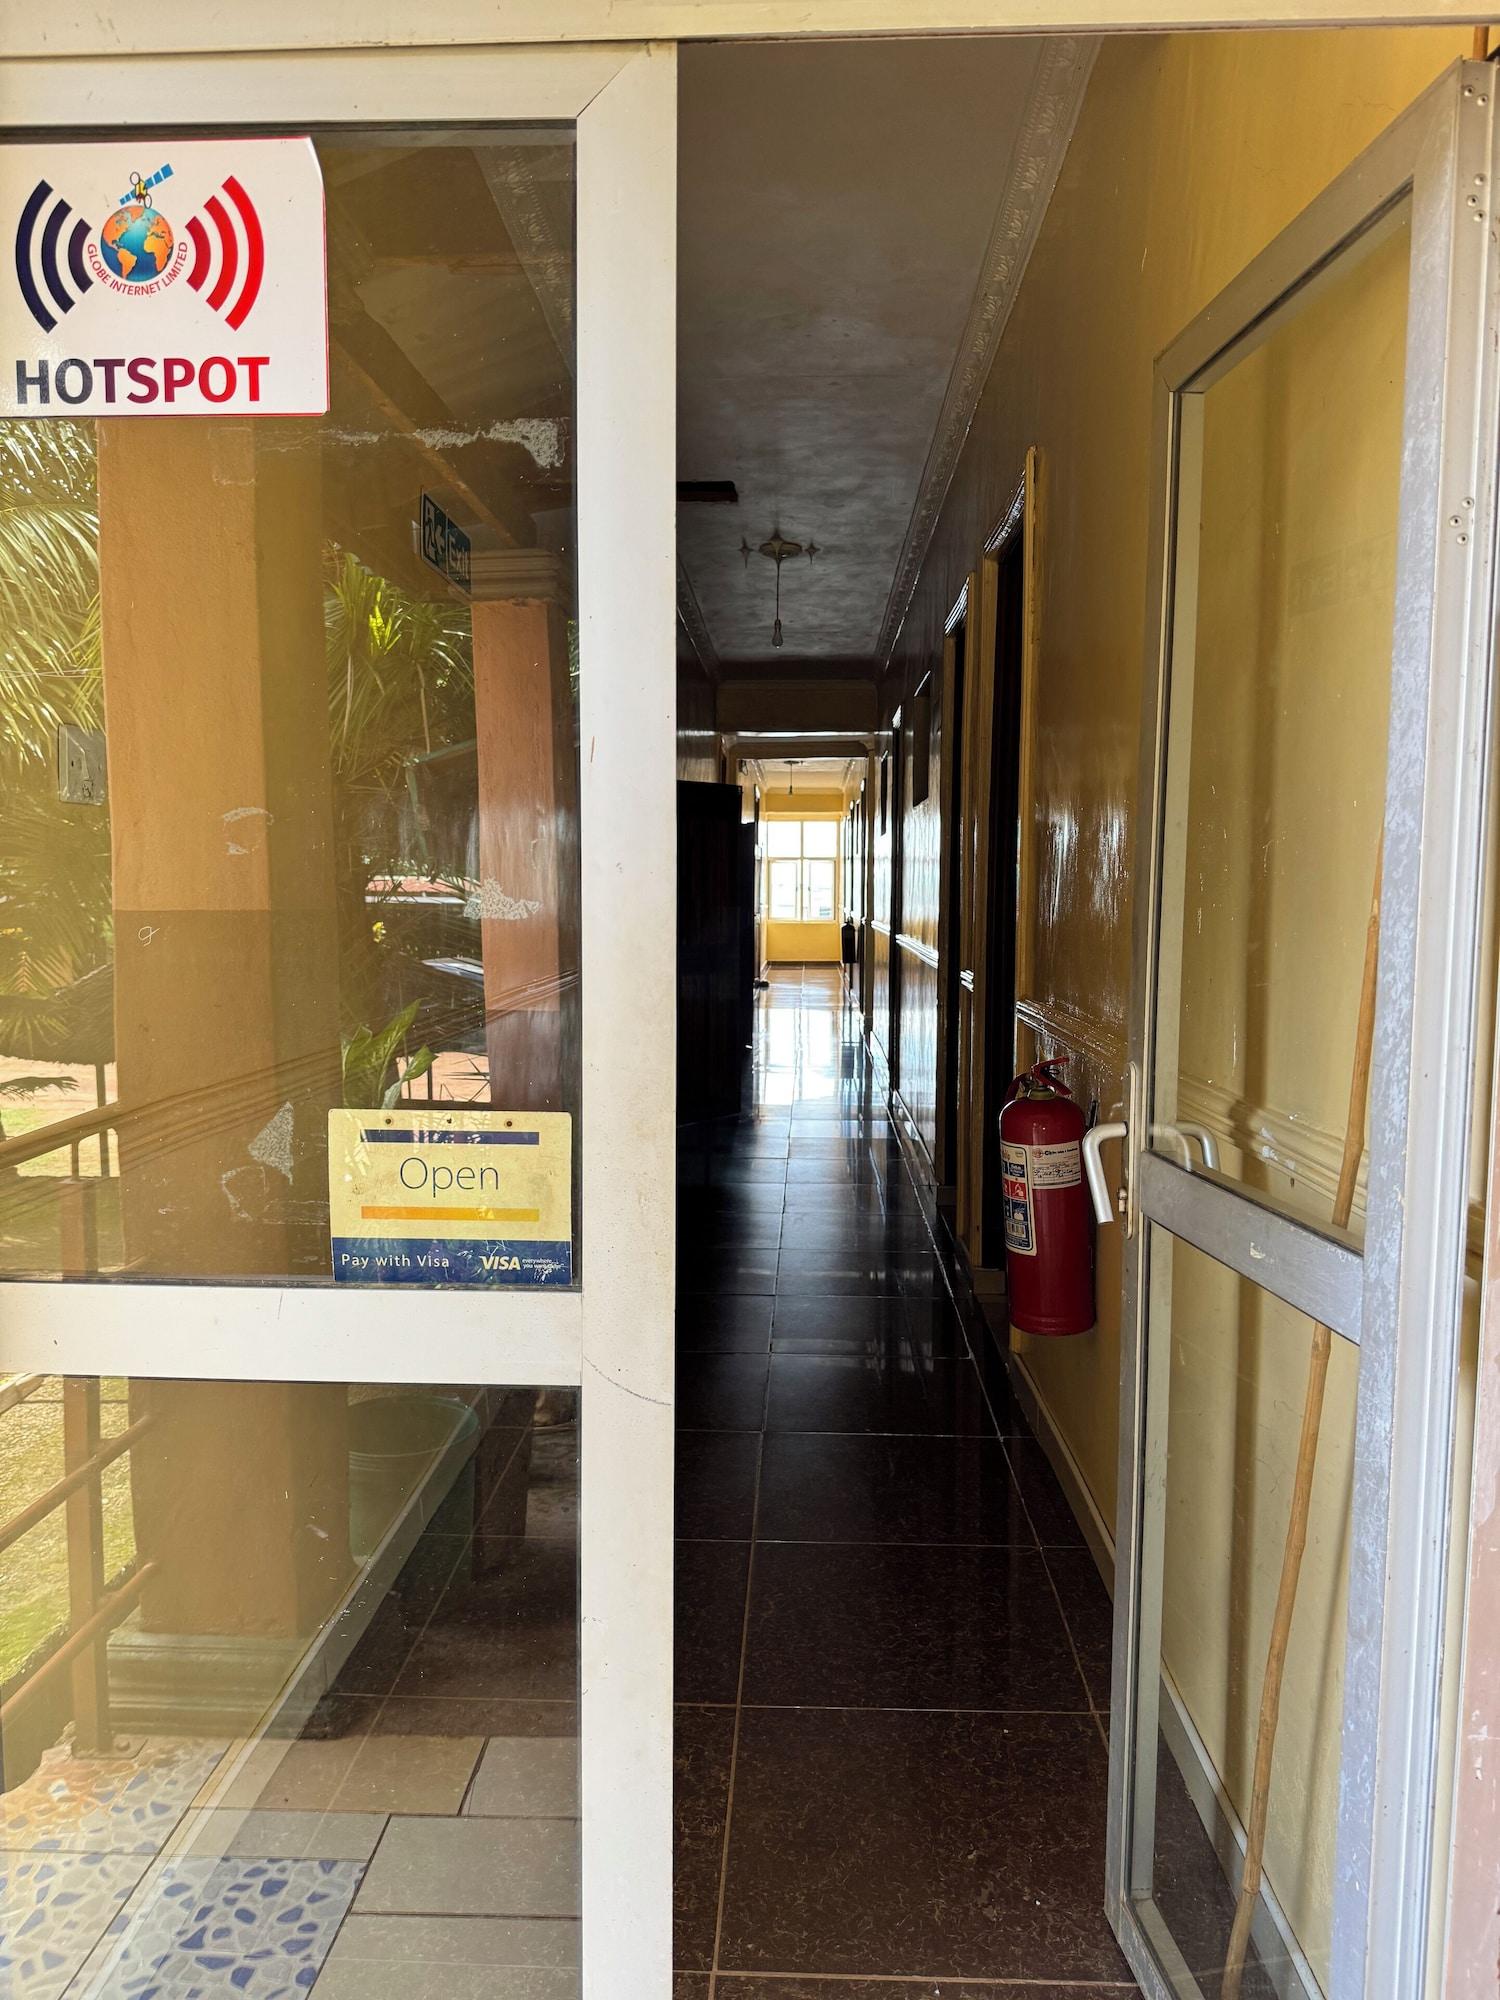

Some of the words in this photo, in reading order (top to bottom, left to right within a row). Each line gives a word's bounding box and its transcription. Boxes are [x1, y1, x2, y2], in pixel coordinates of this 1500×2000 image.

[87, 243, 111, 284] GLOBE
[109, 279, 161, 296] INTERNET
[162, 241, 188, 287] LIMITED
[16, 356, 270, 404] HOTSPOT
[400, 1157, 499, 1198] Open
[341, 1254, 369, 1269] Pay
[376, 1254, 411, 1267] with
[417, 1255, 450, 1267] Visa
[479, 1255, 521, 1270] VISA
